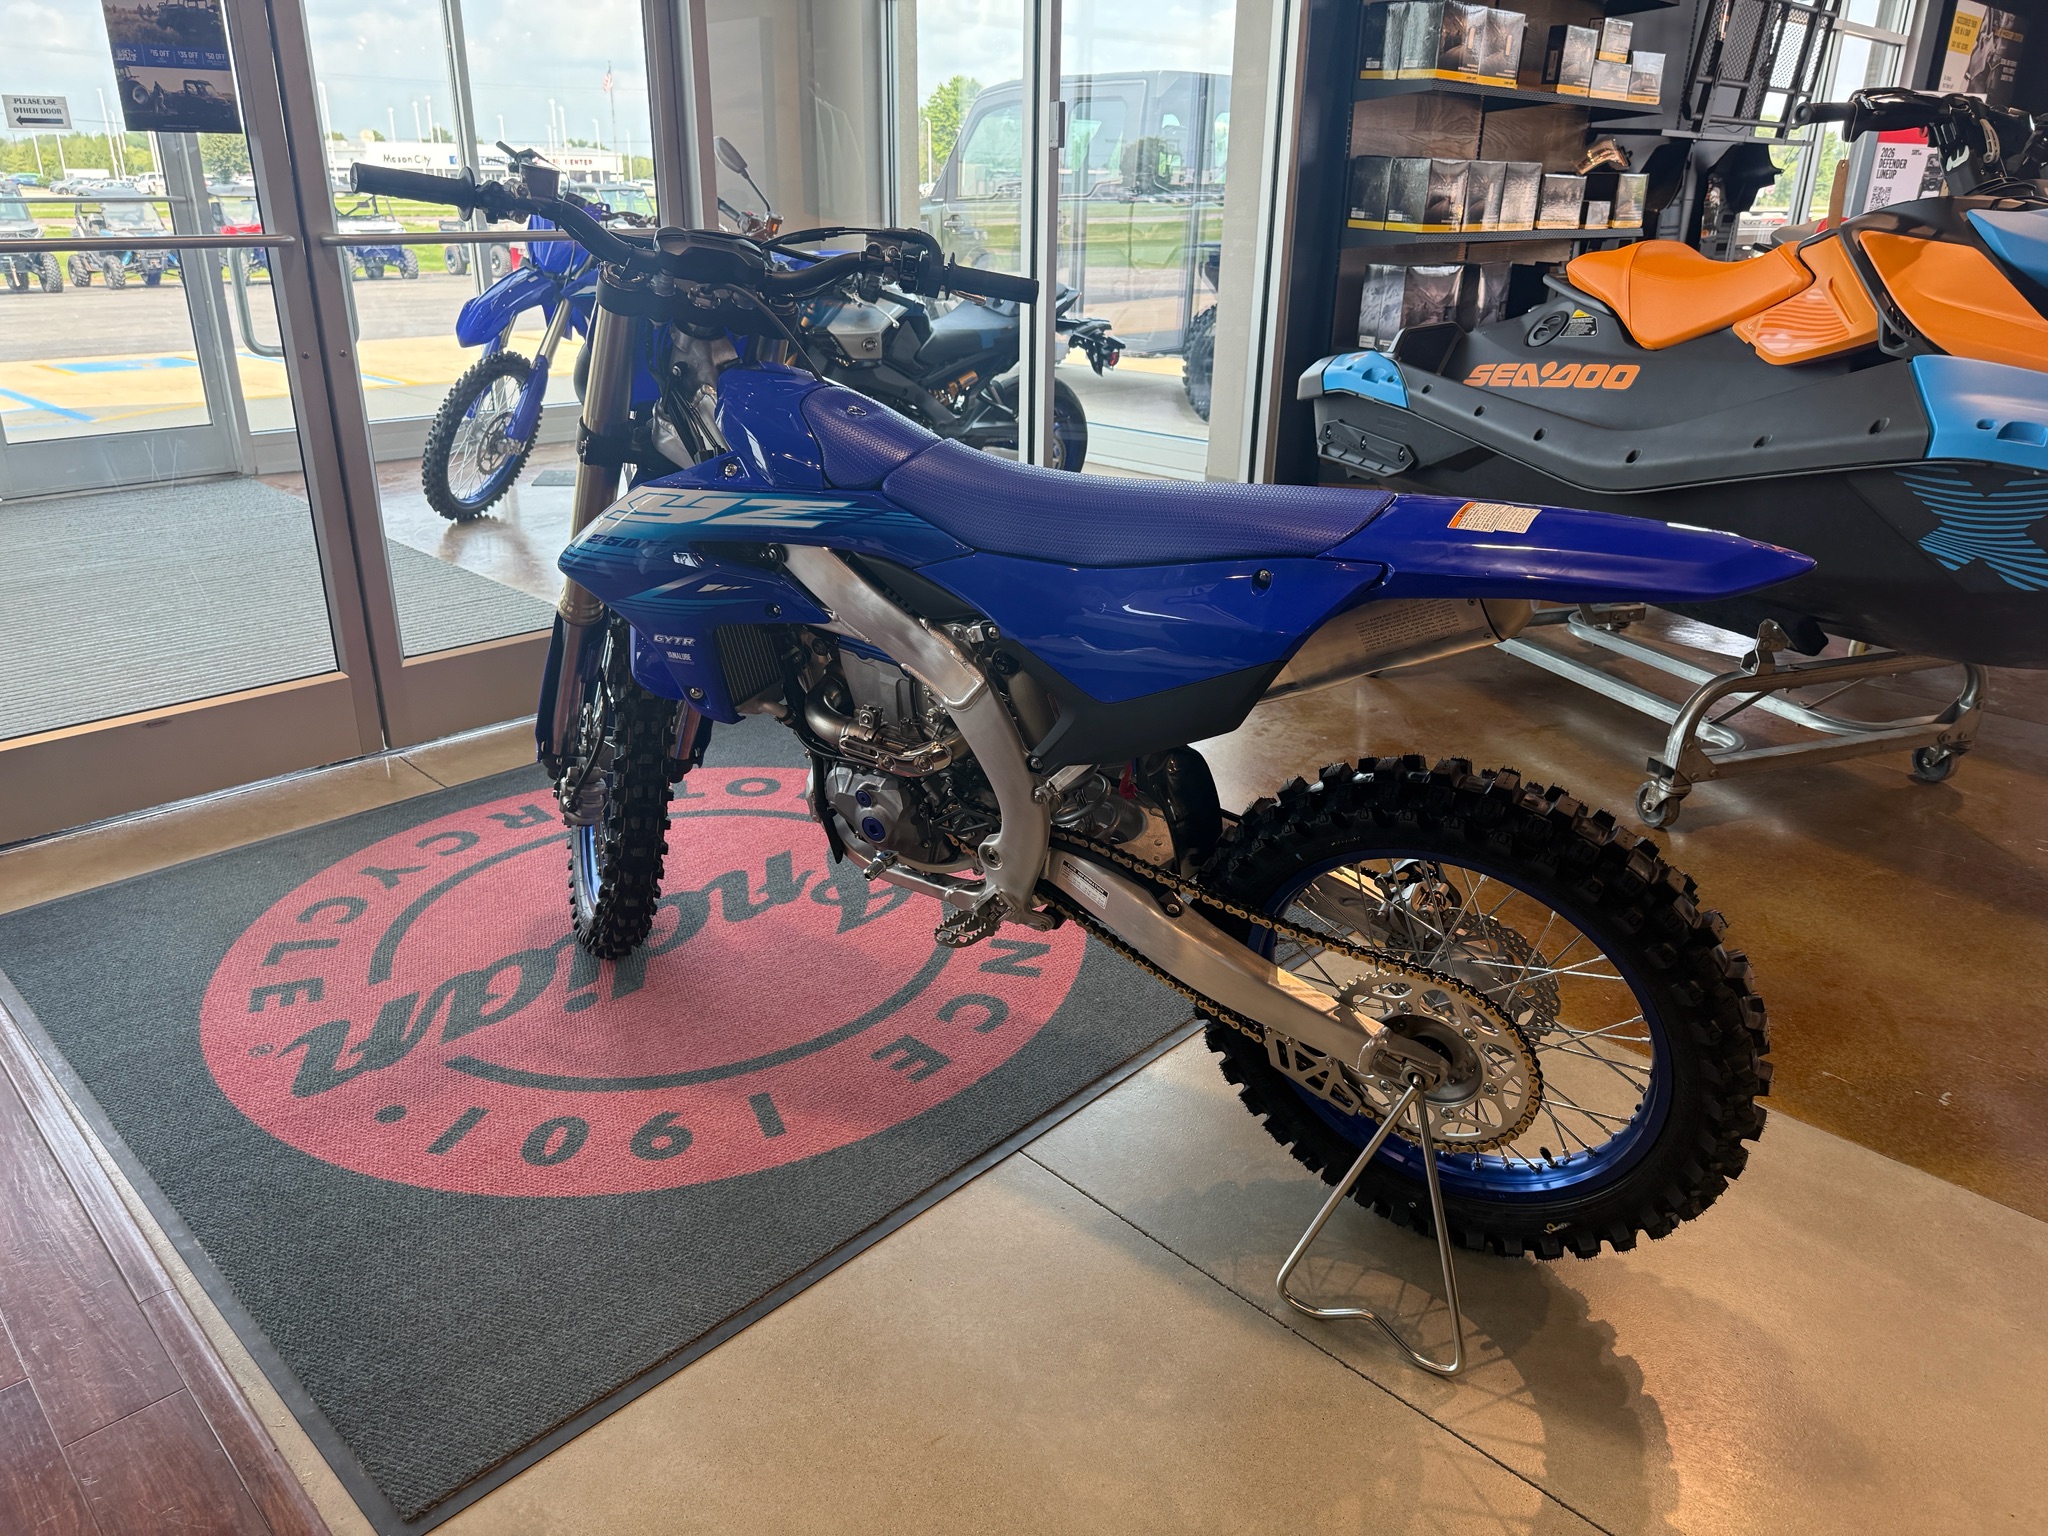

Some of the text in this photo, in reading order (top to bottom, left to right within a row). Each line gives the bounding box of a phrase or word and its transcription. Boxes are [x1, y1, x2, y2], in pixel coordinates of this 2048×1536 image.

[13, 97, 42, 105] PLEASE
[414, 154, 432, 166] City
[1878, 158, 1908, 169] DEFENDER
[1876, 169, 1897, 180] LINEUP
[604, 490, 857, 529] YZ
[653, 633, 696, 647] GYTR
